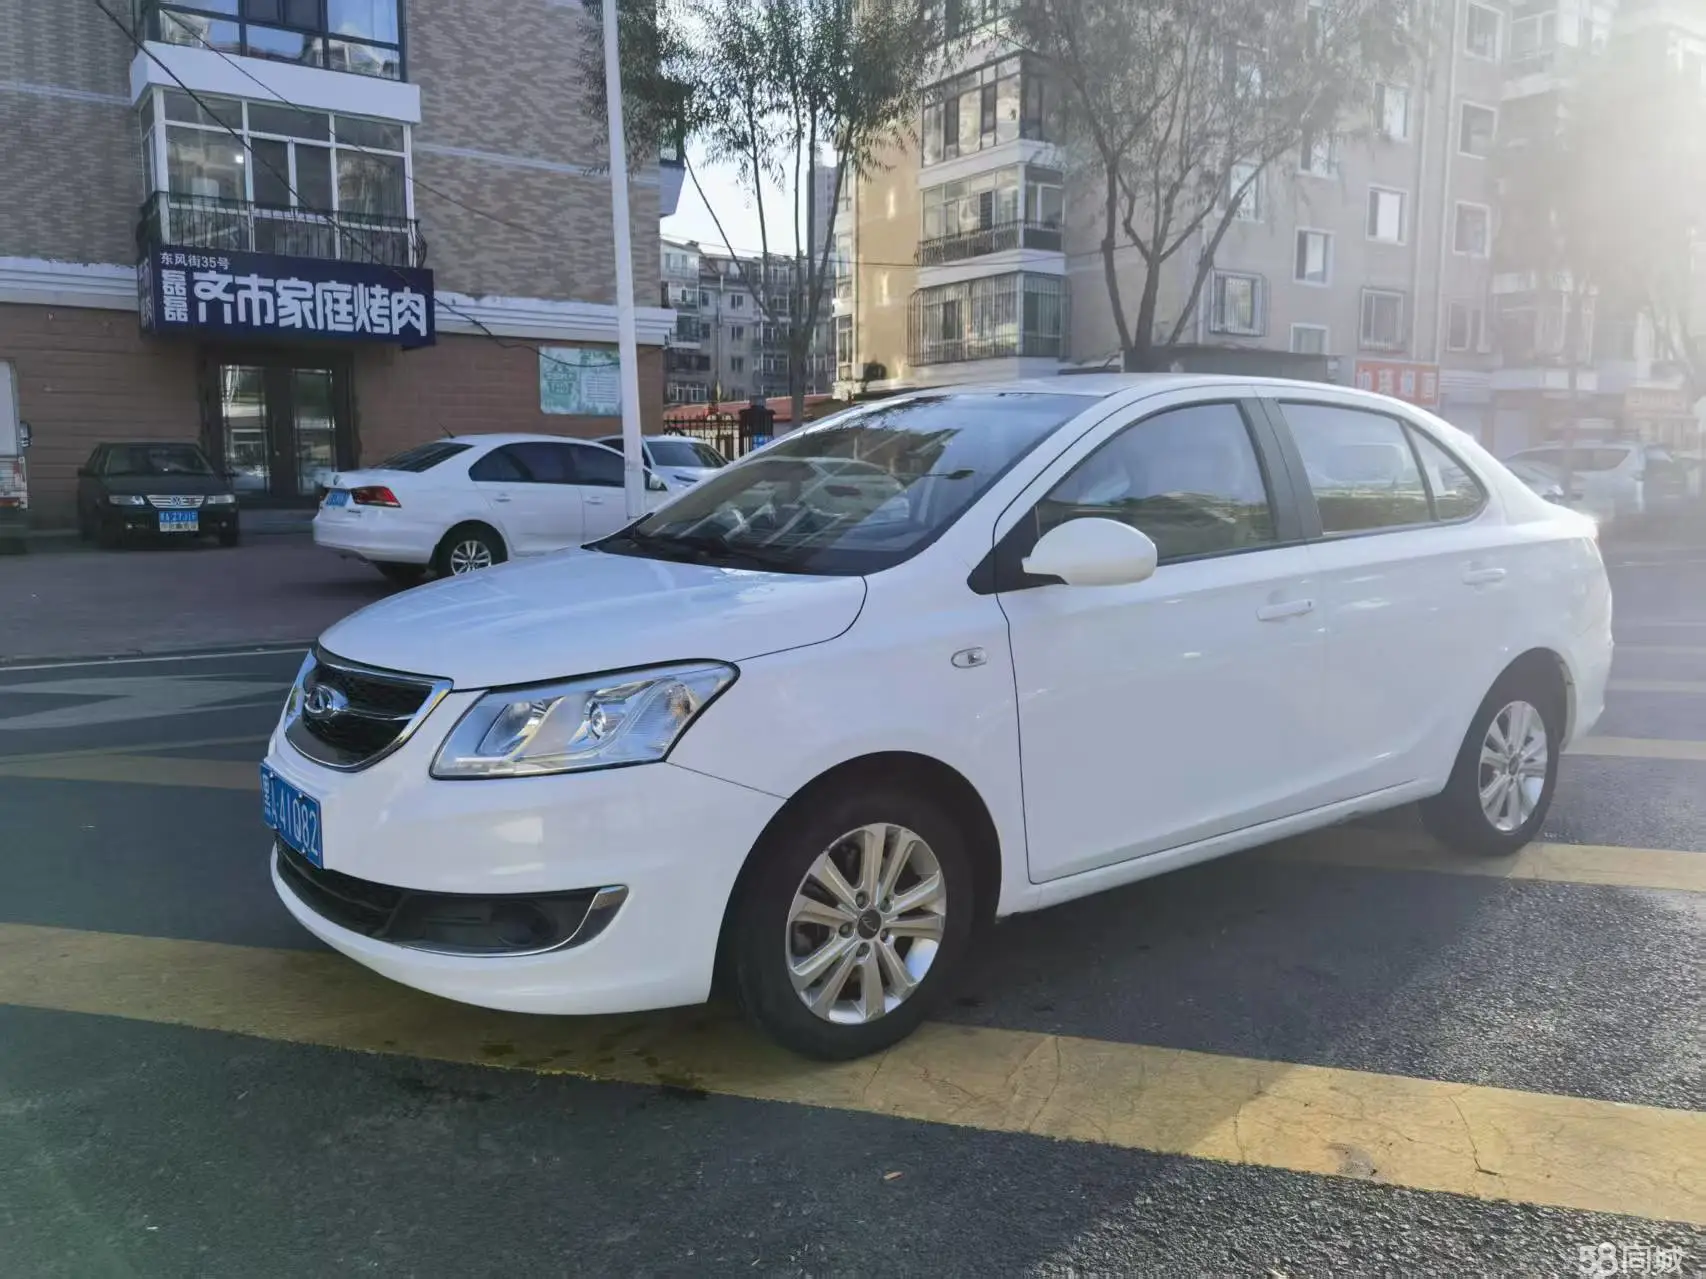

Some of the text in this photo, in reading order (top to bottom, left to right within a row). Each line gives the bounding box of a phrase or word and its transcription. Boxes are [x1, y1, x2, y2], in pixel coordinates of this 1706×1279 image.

[159, 252, 230, 271] 东风街35号
[161, 269, 188, 322] 磊磊
[192, 270, 428, 337] 齐市家庭烤肉
